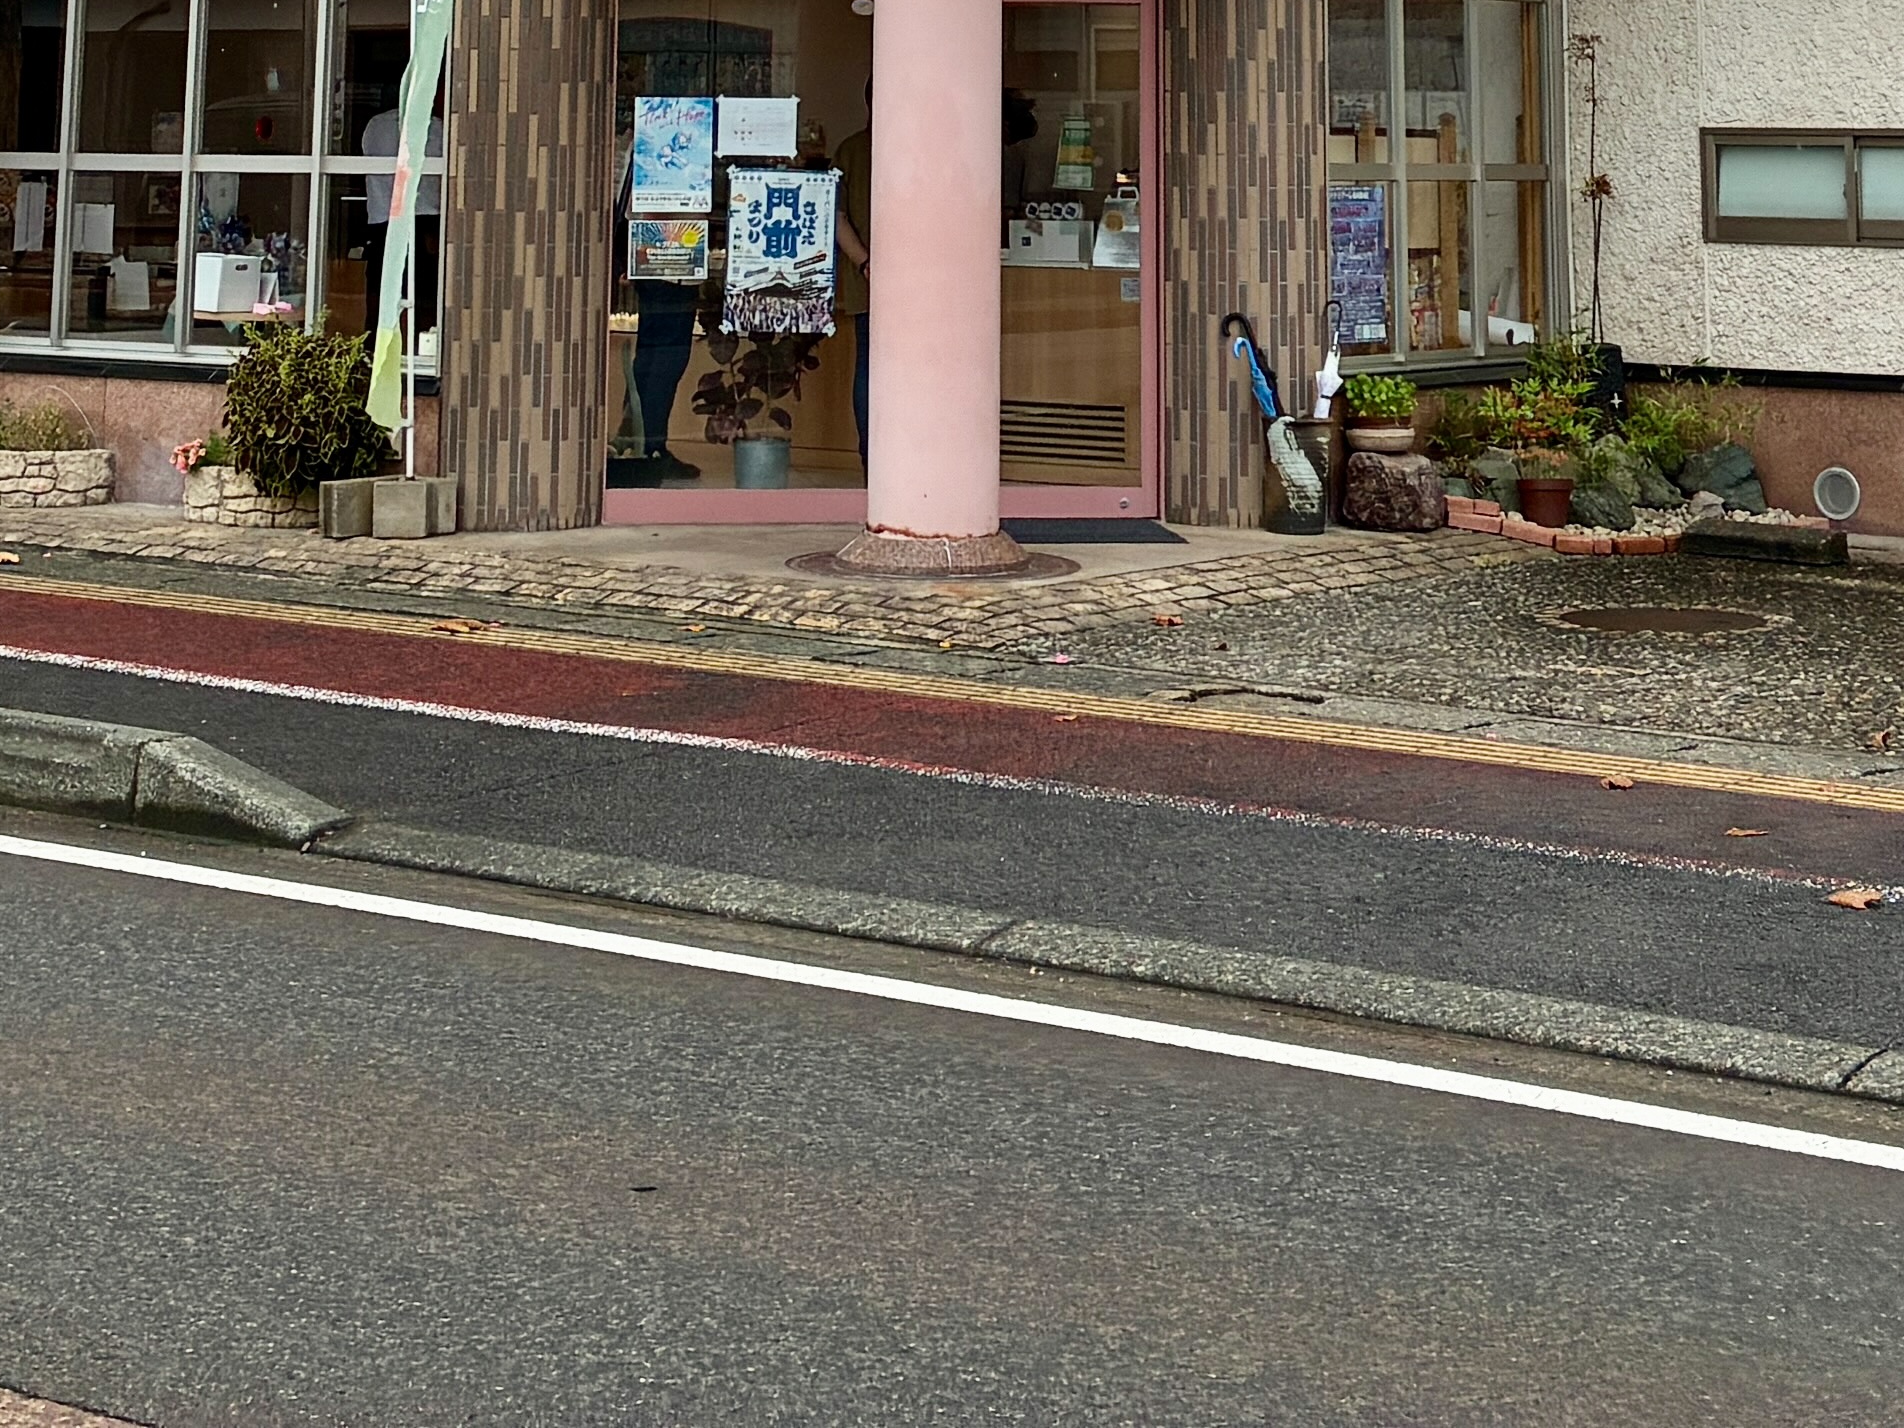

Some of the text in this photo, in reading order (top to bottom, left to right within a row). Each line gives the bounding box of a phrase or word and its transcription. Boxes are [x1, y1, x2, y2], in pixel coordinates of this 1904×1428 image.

[747, 199, 763, 244] まつり
[761, 181, 803, 259] 門前
